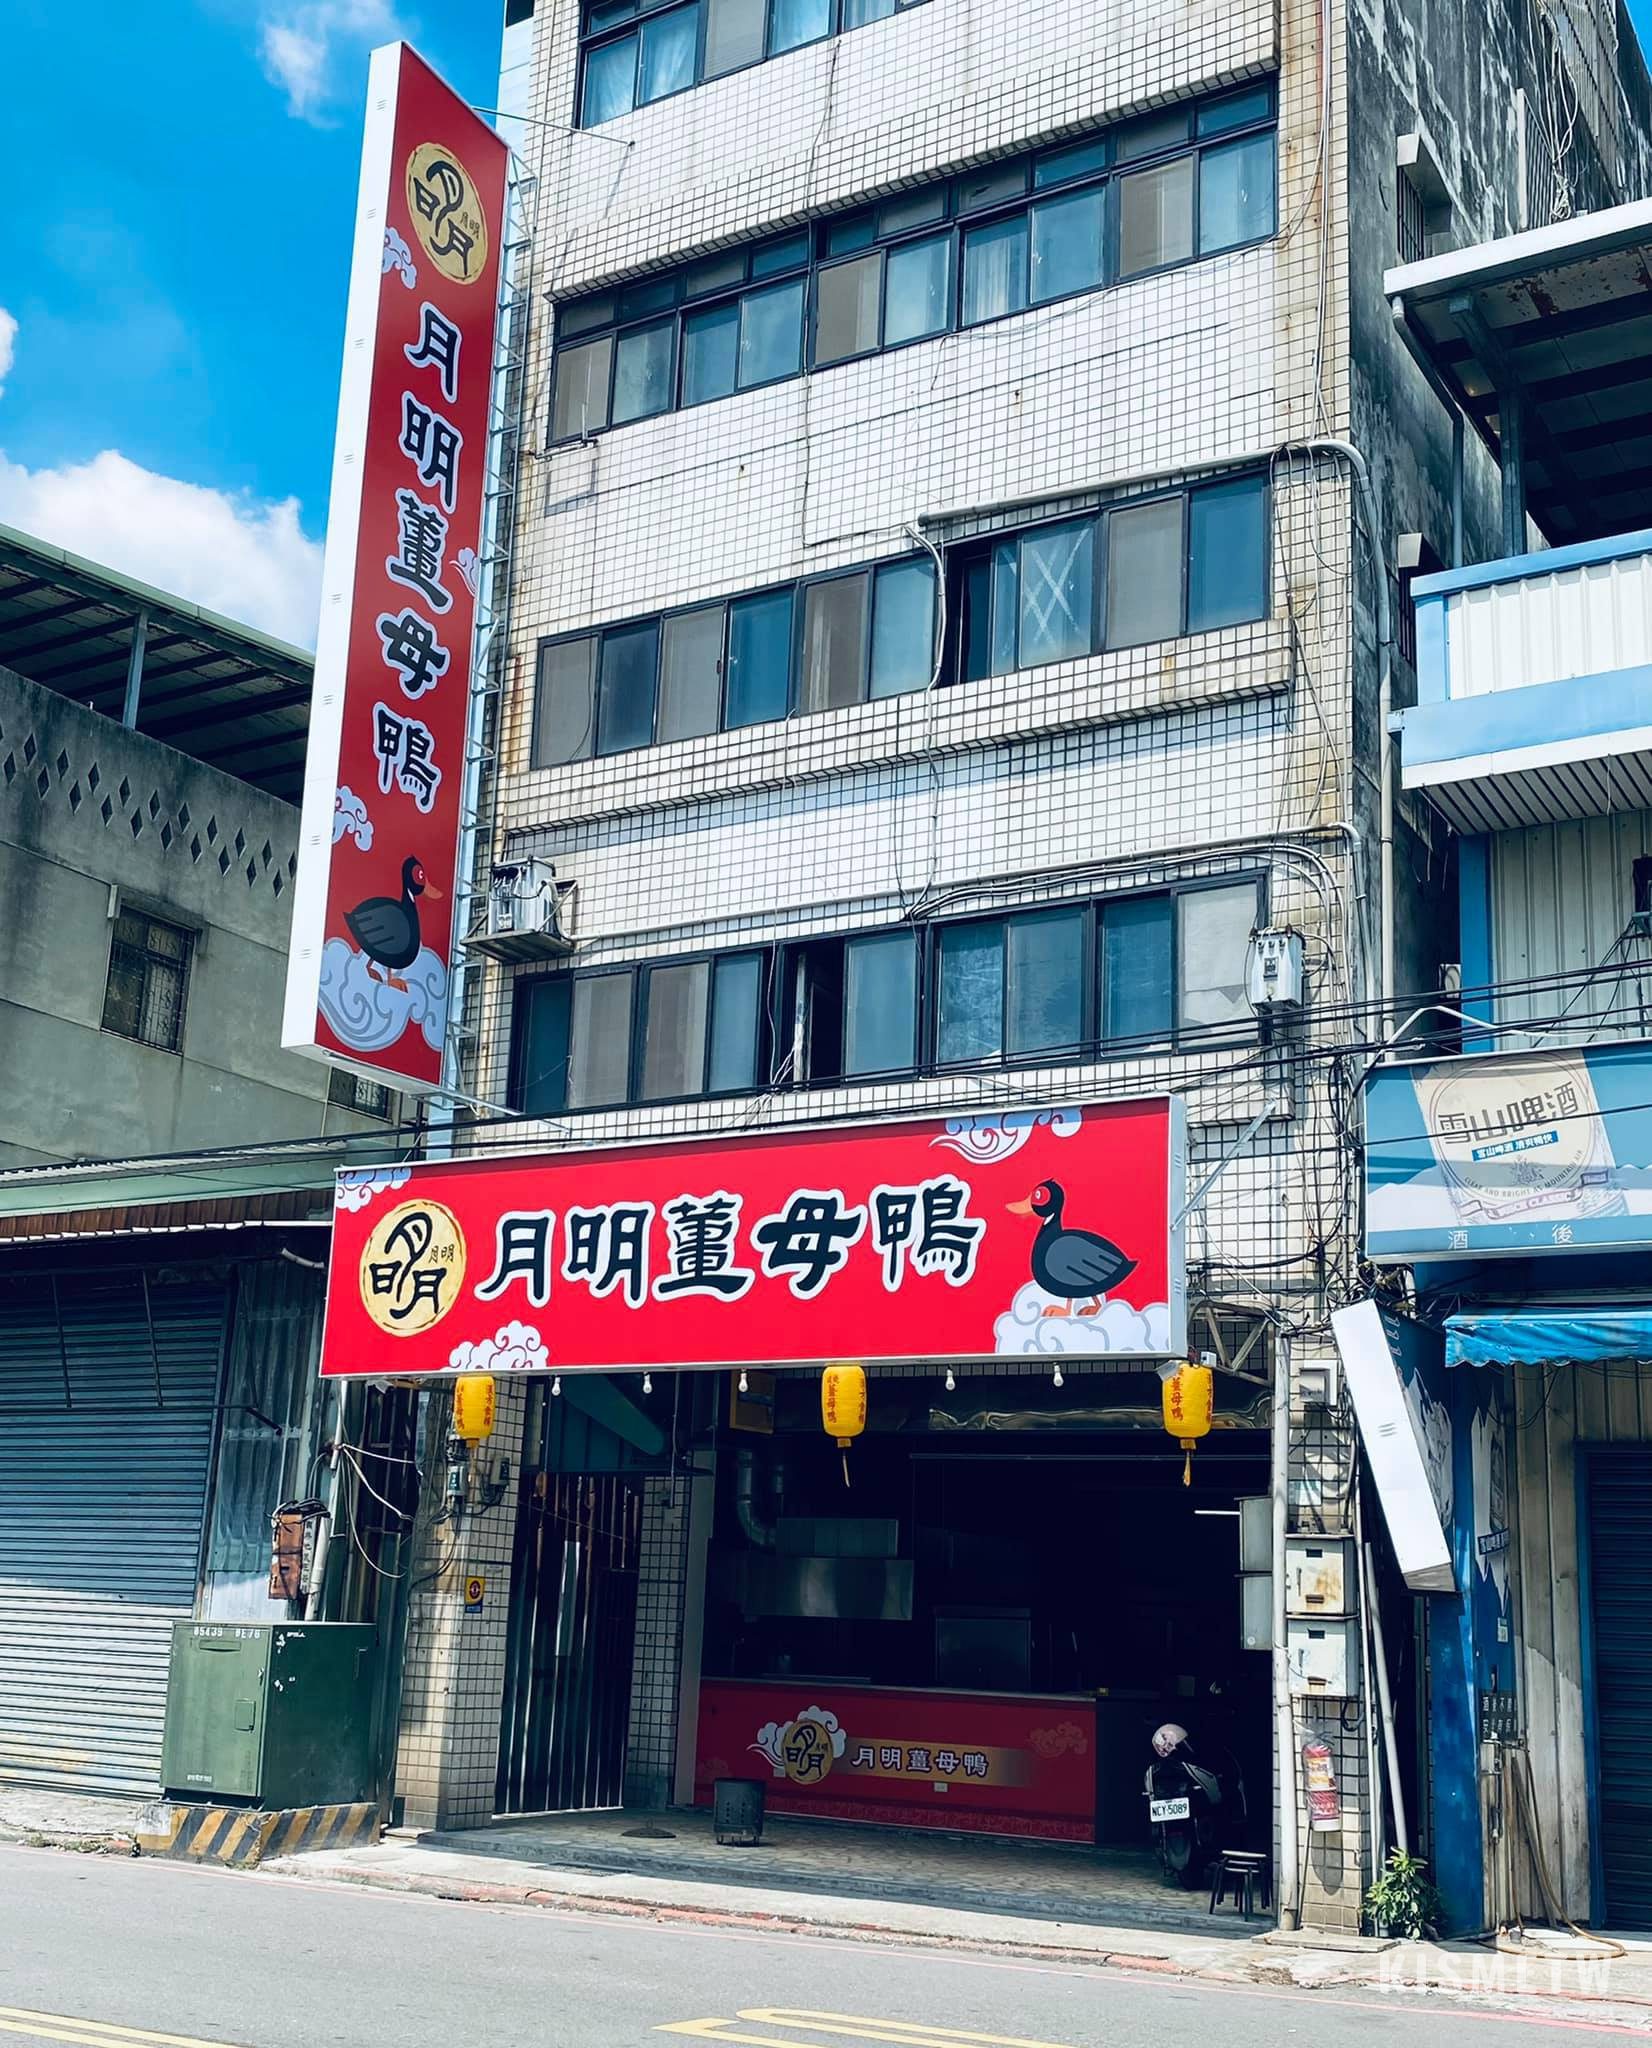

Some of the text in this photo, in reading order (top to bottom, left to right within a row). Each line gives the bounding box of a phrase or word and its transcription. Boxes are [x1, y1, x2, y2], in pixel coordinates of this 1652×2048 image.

[376, 303, 463, 809] 月明薑母鴨
[1437, 1081, 1579, 1144] 雪山啤酒
[478, 1179, 983, 1304] 月明薑母鴨
[851, 1746, 989, 1778] 月明薑母鴨
